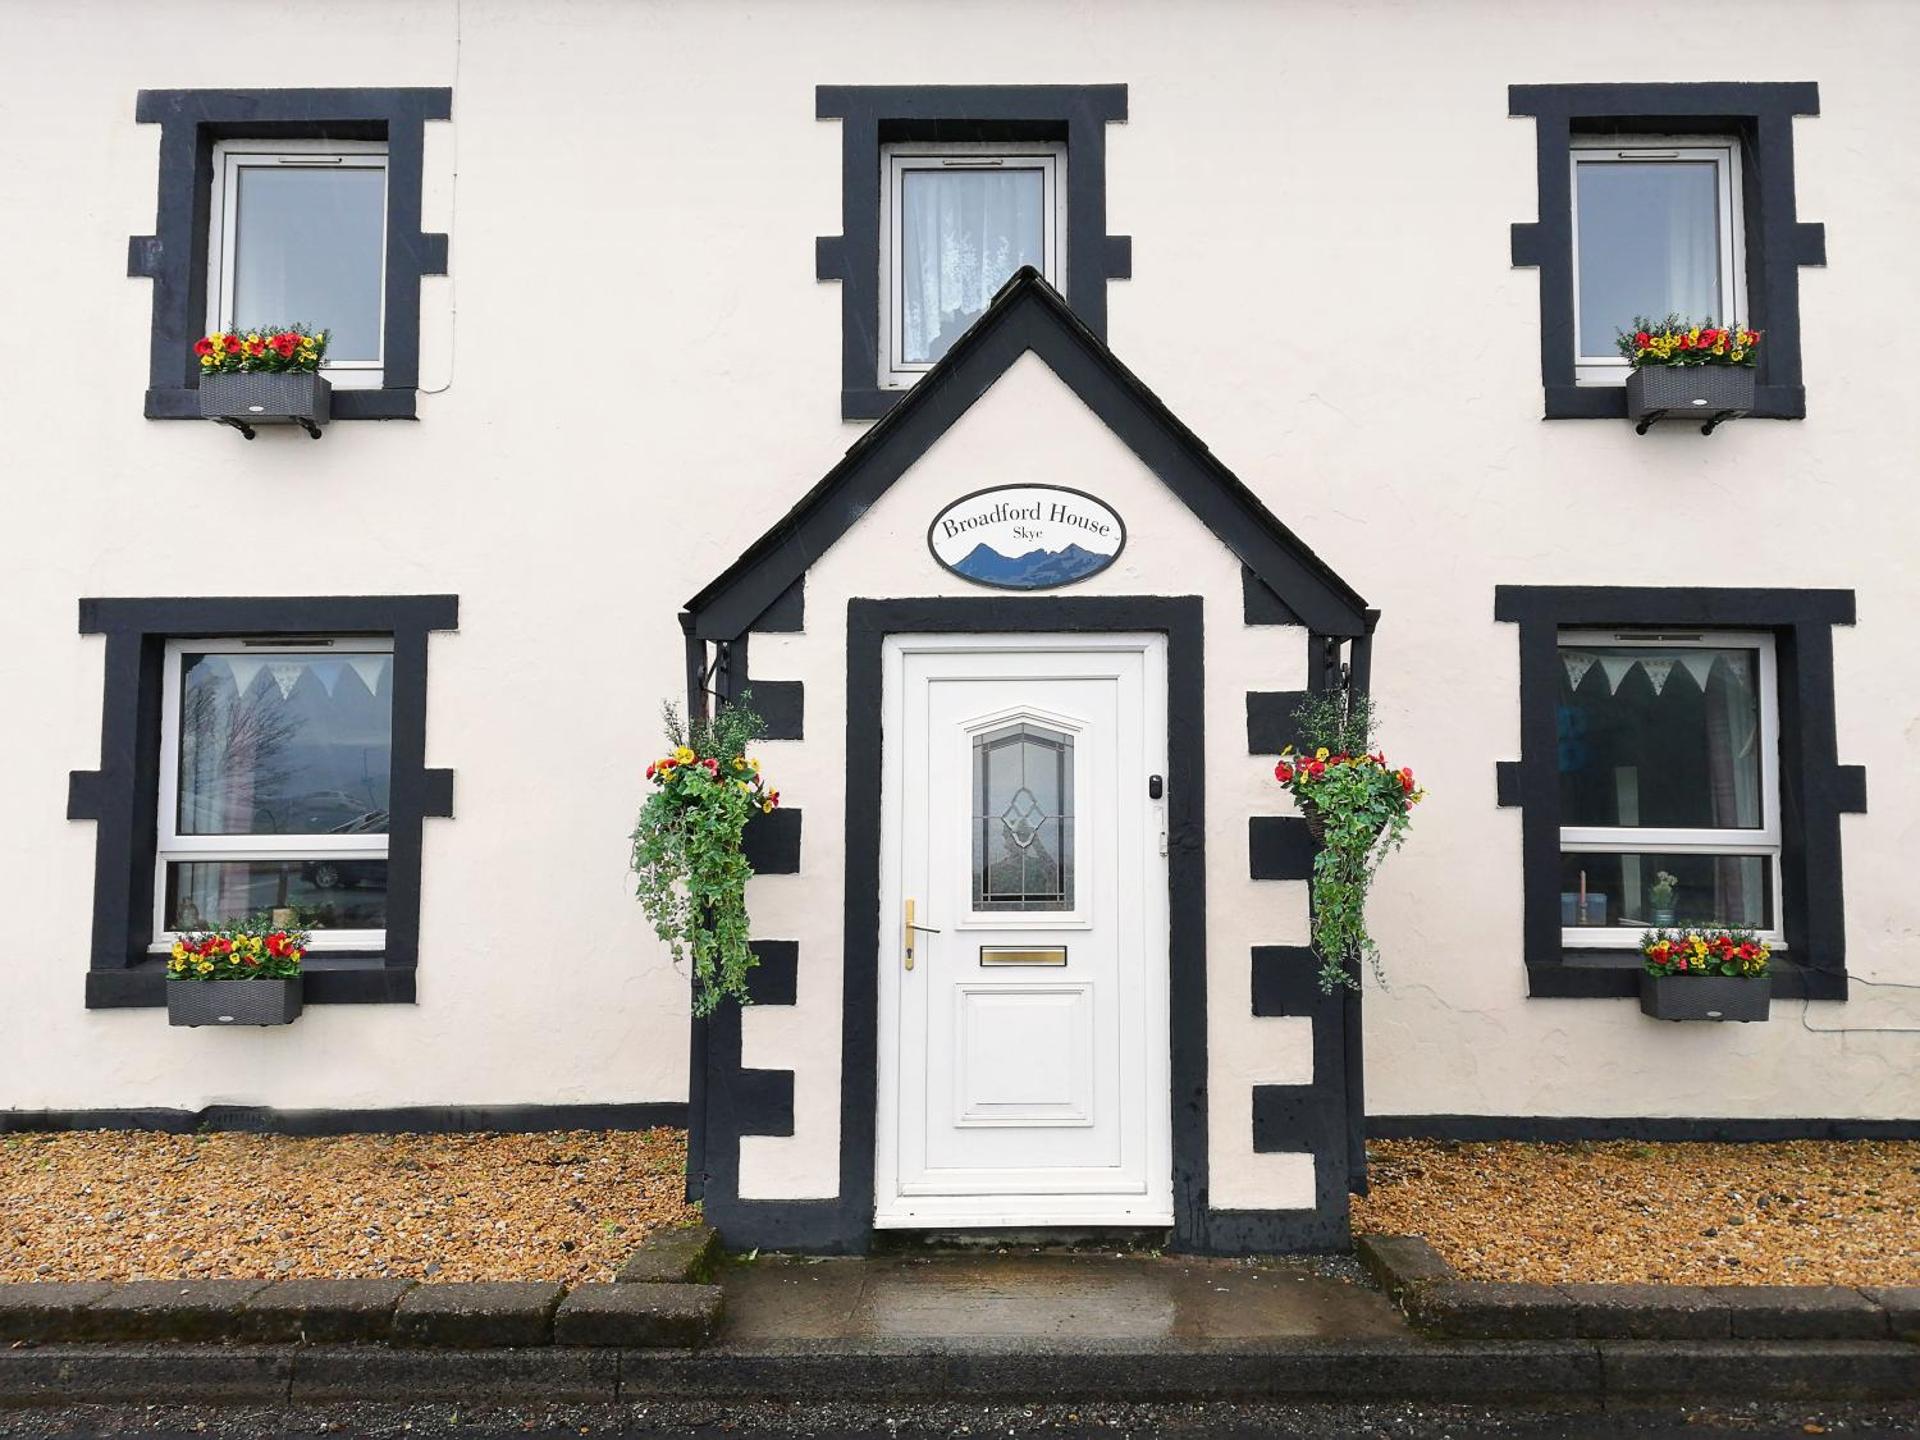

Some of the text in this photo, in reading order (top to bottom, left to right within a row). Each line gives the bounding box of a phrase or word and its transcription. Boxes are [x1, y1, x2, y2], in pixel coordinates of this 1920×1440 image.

[942, 501, 1110, 539] Broadford House
[1012, 526, 1043, 542] Skye
